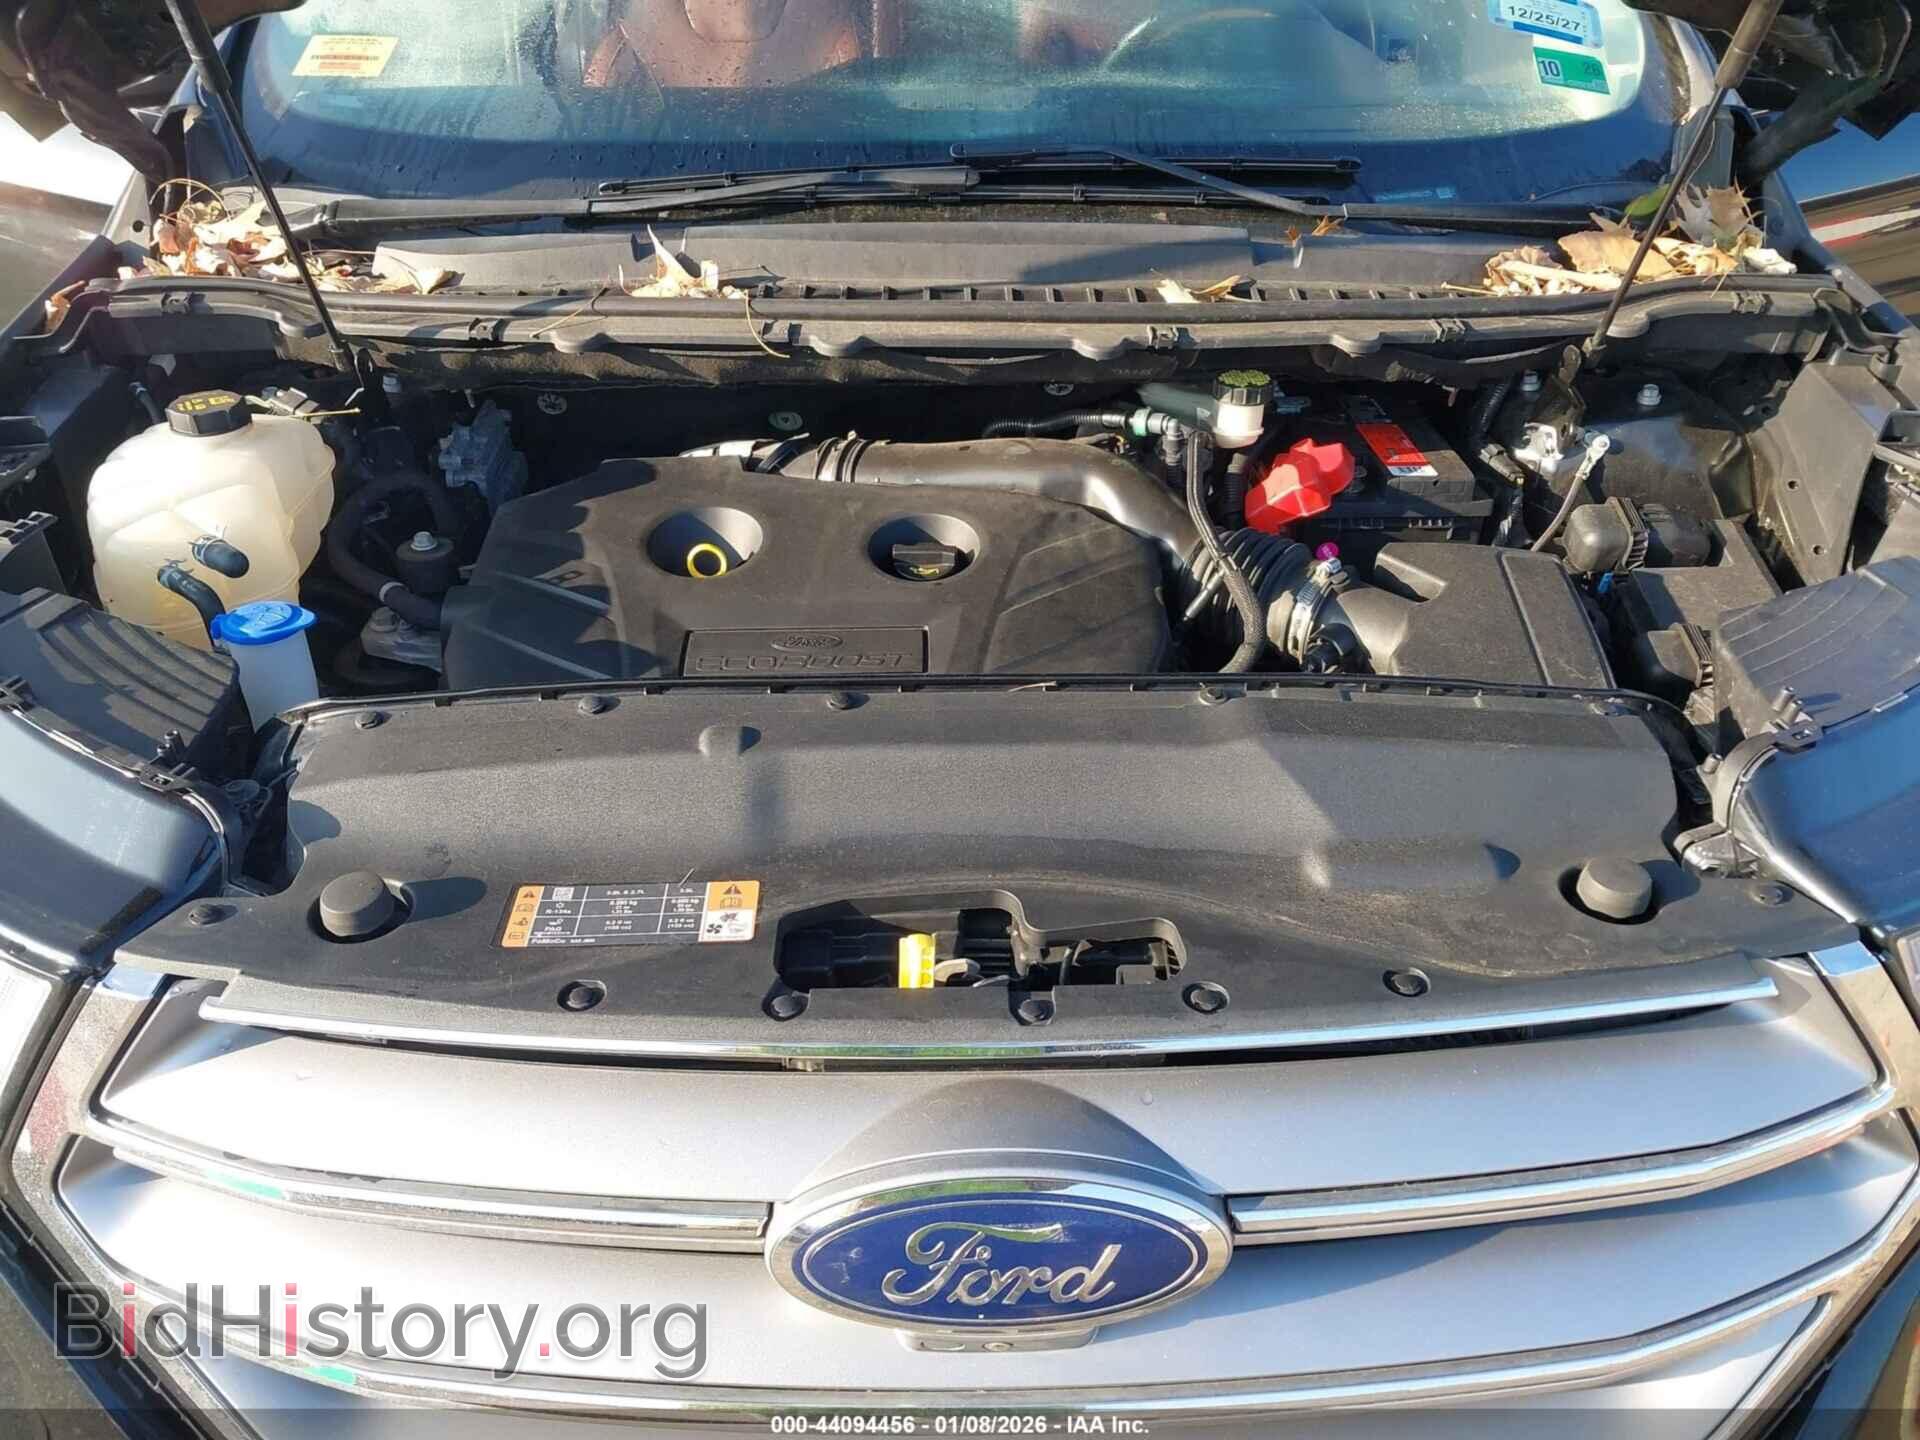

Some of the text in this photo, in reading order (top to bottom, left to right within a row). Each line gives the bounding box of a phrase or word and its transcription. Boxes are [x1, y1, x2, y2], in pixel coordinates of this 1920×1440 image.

[1508, 5, 1581, 31] 12/25/27
[1538, 60, 1561, 77] 10
[881, 1221, 1123, 1306] Ford
